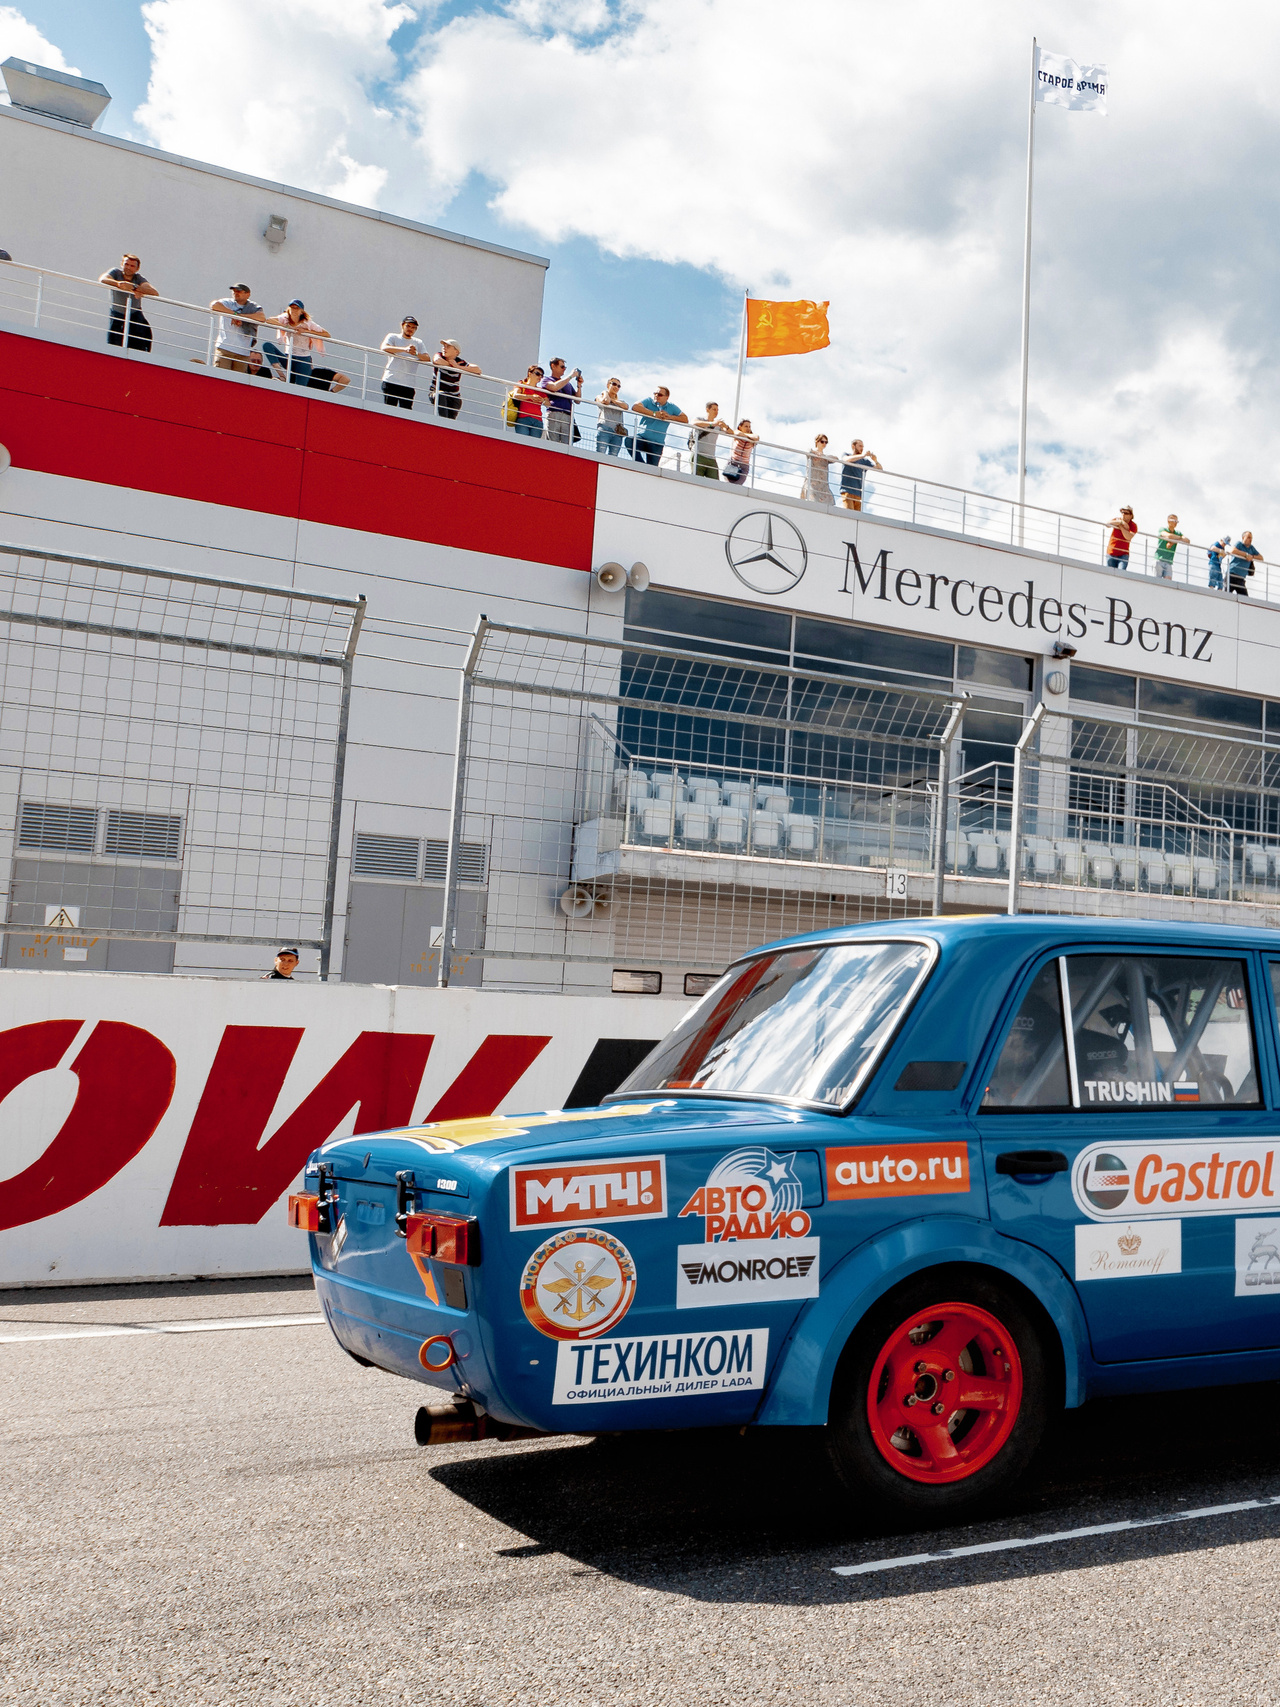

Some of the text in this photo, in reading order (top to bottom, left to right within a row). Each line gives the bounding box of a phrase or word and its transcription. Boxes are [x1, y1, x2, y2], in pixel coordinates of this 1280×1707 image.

[1037, 70, 1073, 89] СТАРОЕ
[838, 541, 1213, 663] Mercedes-Benz
[889, 873, 906, 895] 13
[1084, 1080, 1172, 1102] TRUSHIN
[437, 1178, 458, 1191] 1300
[834, 1155, 962, 1186] auto.ru
[1134, 1150, 1275, 1206] Castrol
[526, 1170, 654, 1216] МАТЧ!
[678, 1184, 768, 1218] АВТО
[705, 1209, 812, 1243] РАДИО
[523, 1230, 635, 1286] ДОСААФ РОССИИ
[699, 1256, 800, 1285] MONROE
[1089, 1249, 1170, 1274] Romanoff
[570, 1334, 753, 1386] ТЕХИНКОМ
[566, 1377, 753, 1400] ОФИЦИАЛЬНЫЙ ДИЛЕР LADA
